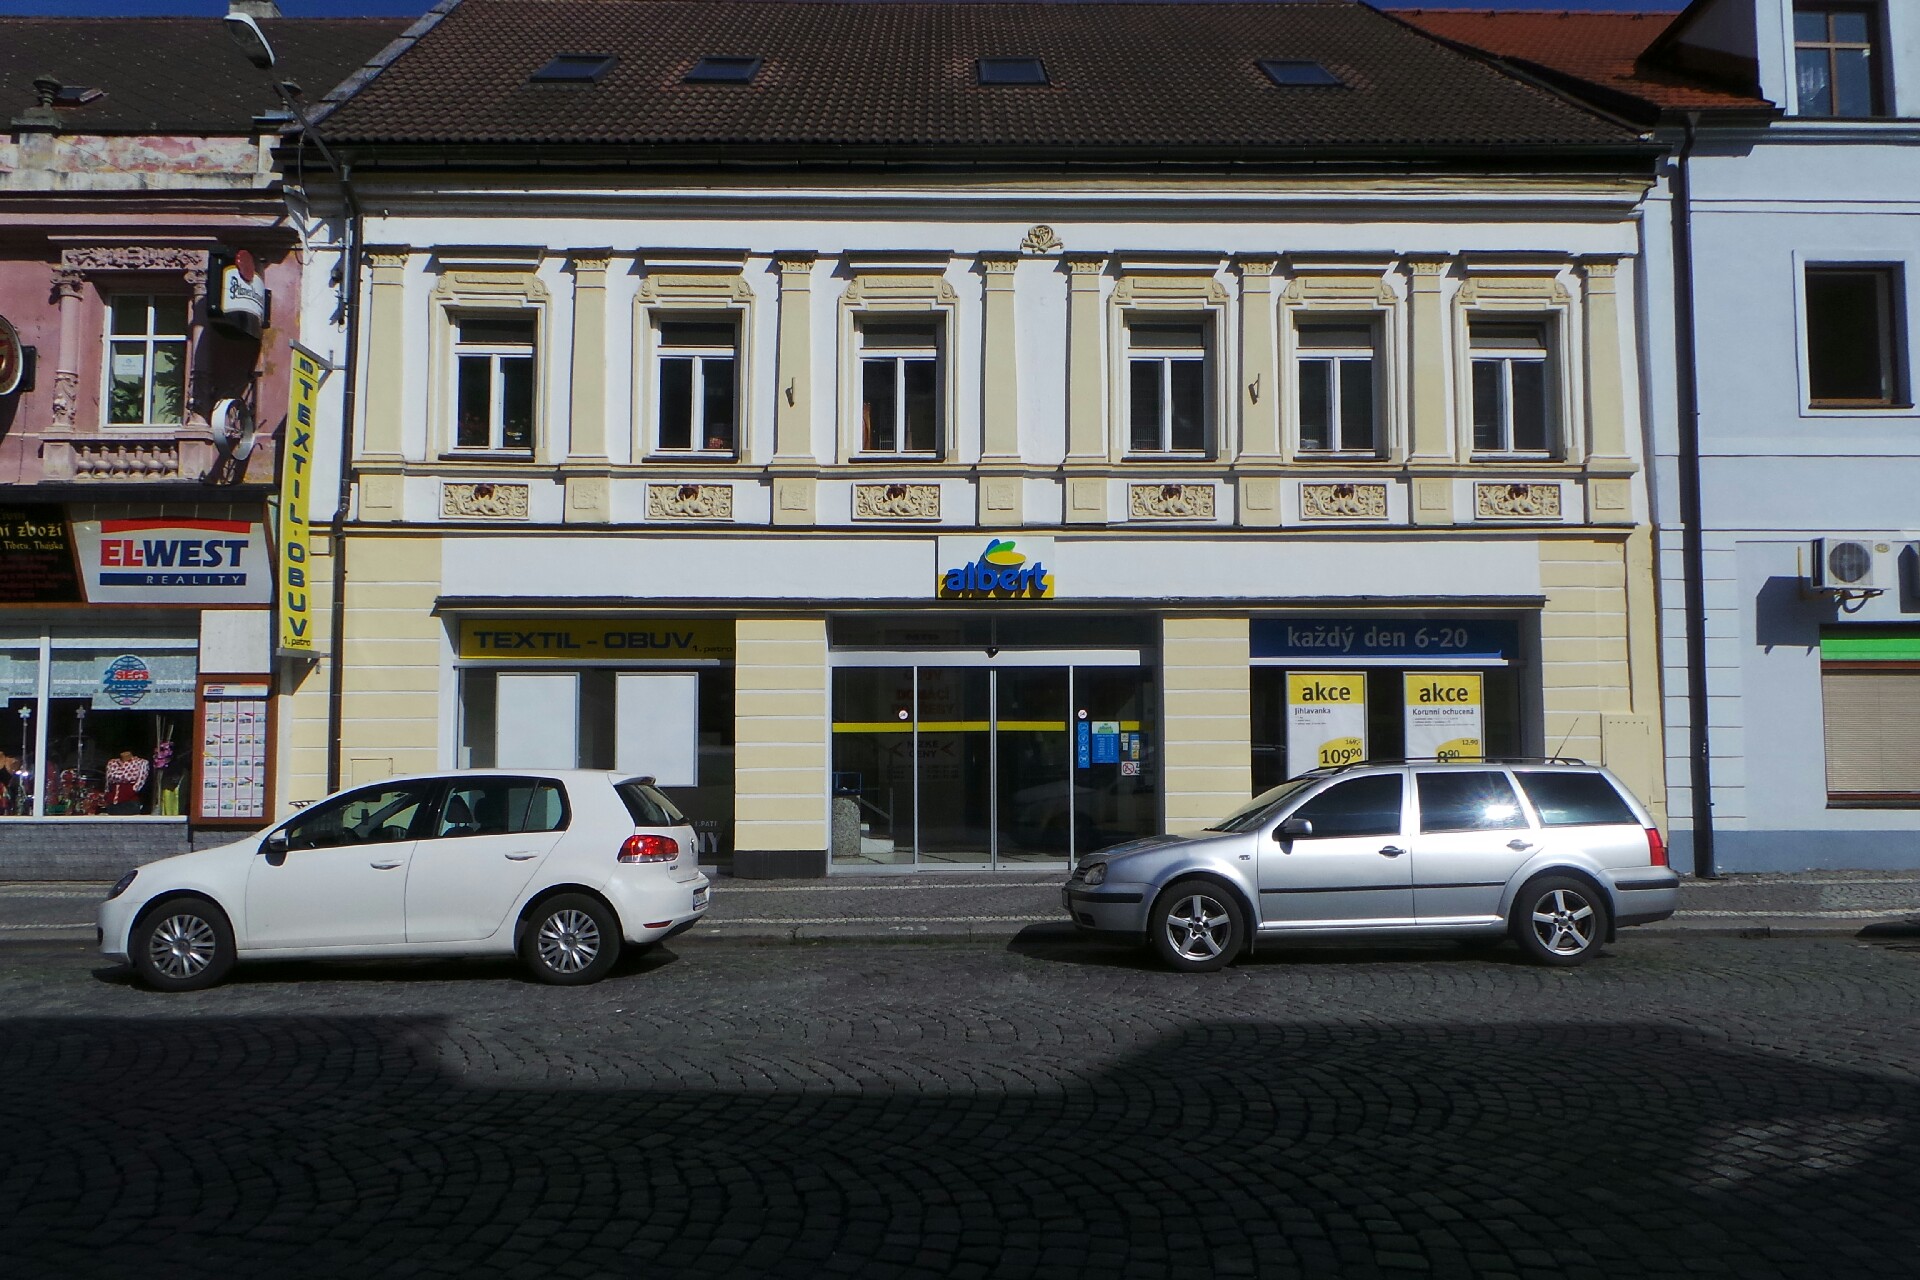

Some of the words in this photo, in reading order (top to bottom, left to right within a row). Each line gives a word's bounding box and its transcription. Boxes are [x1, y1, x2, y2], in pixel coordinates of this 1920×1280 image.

[17, 520, 63, 537] zboží
[146, 575, 240, 585] REALITY
[946, 561, 1048, 591] albert
[473, 631, 580, 649] TEXTIL
[603, 631, 694, 649] OBUV
[1287, 626, 1355, 652] každý
[1364, 626, 1406, 647] den
[1414, 628, 1468, 647] 6-20
[1302, 681, 1351, 702] akce
[1419, 682, 1469, 703] akce
[1295, 707, 1331, 715] Jihlavanka
